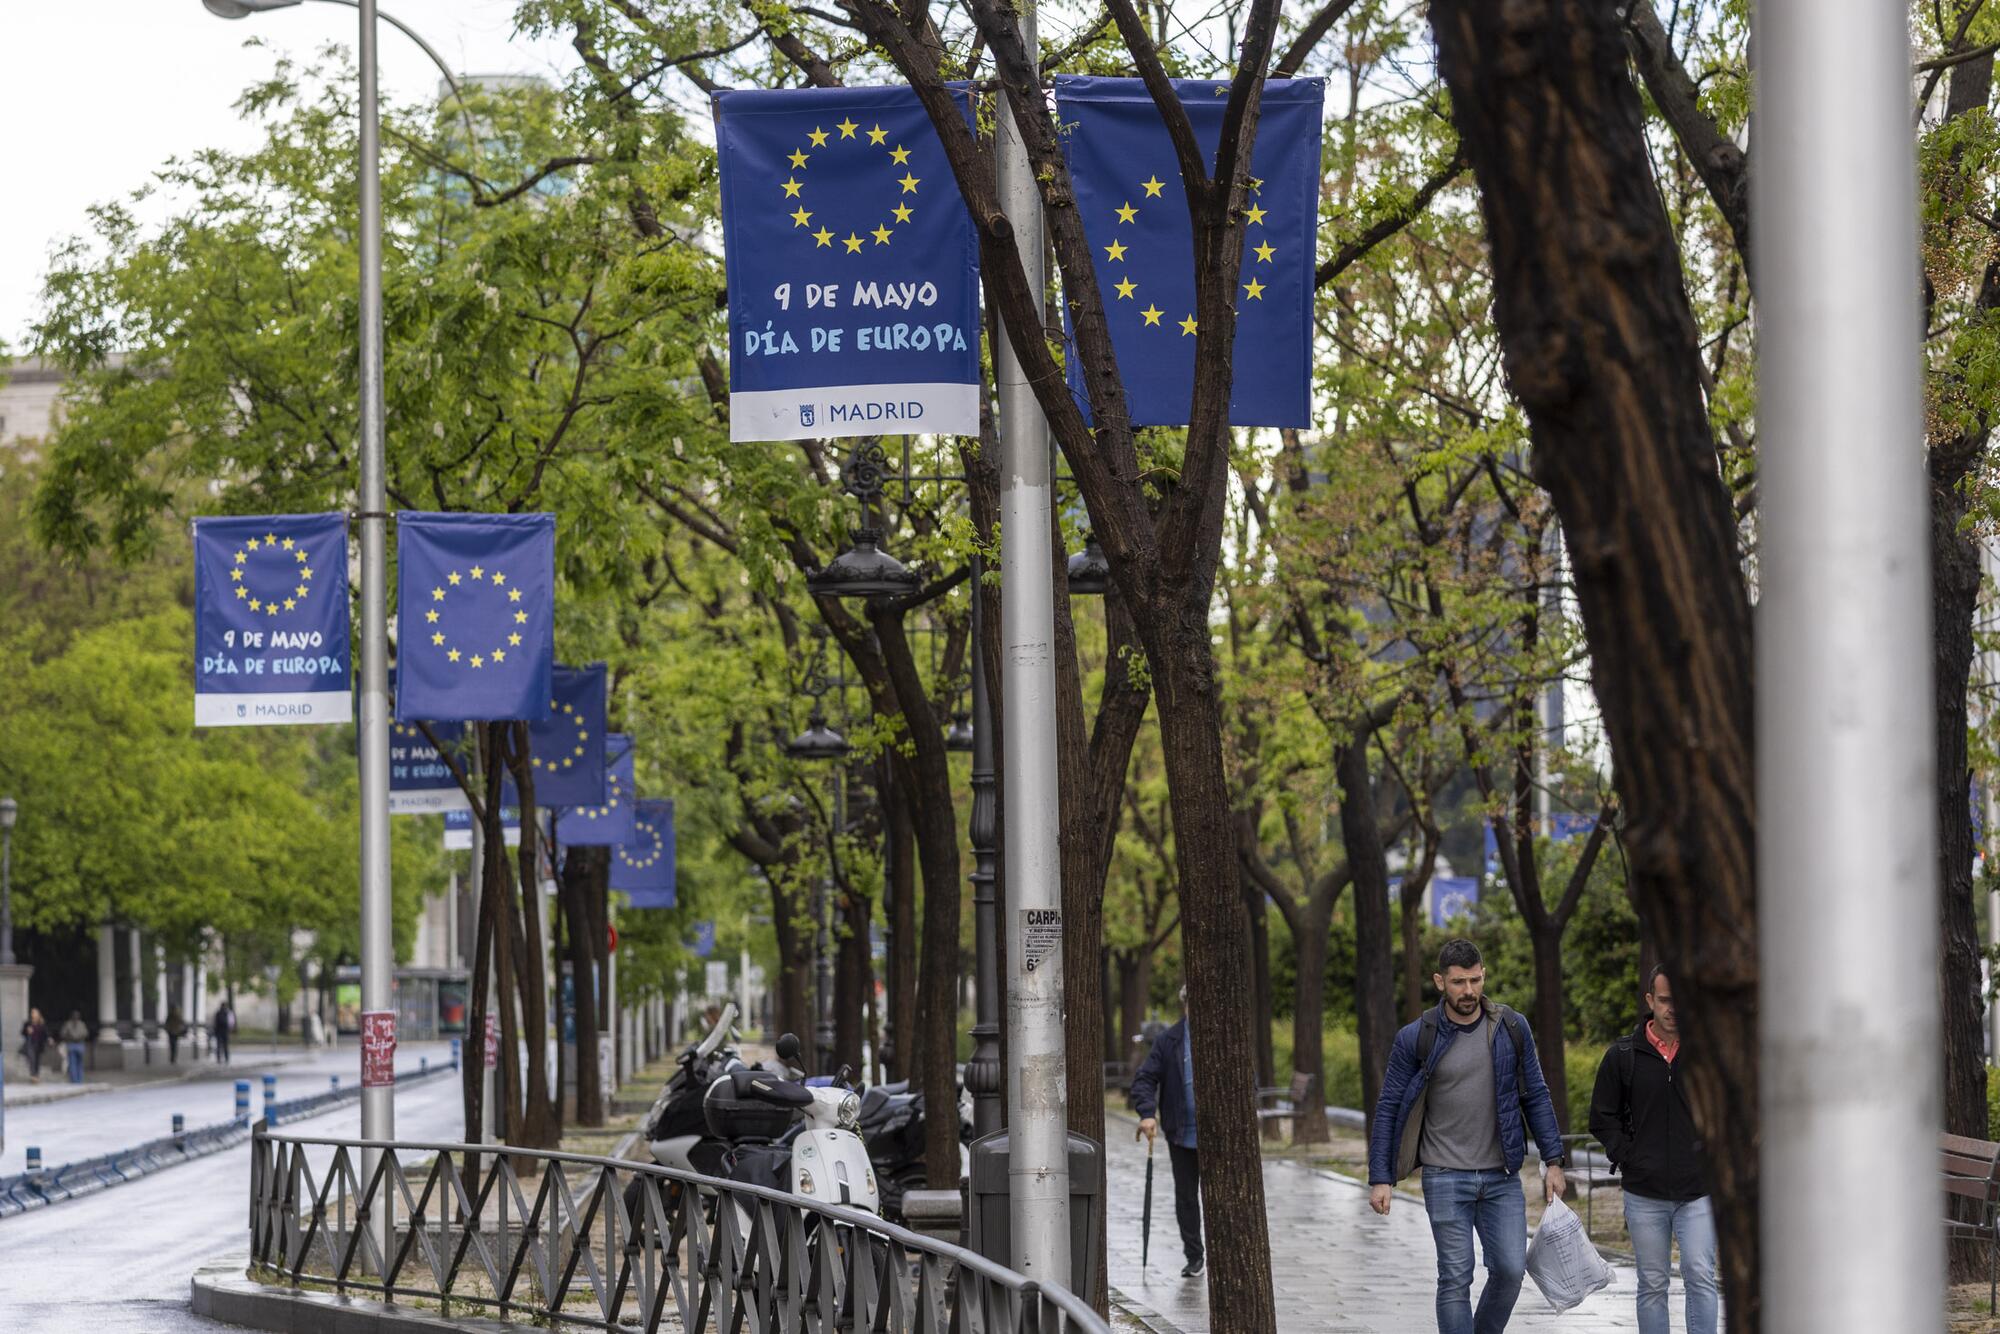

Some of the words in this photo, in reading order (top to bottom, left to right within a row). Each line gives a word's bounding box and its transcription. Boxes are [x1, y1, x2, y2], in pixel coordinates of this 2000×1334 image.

[774, 283, 791, 311] 9
[805, 283, 840, 310] DE
[852, 281, 938, 311] MAYO
[745, 320, 800, 356] DÍA
[811, 327, 844, 353] DE
[856, 323, 968, 353] EUROPA
[830, 401, 924, 423] MADRID
[223, 629, 236, 648] 9
[243, 631, 264, 648] DE
[270, 630, 323, 650] MAYO
[203, 651, 239, 675] DÍA
[245, 657, 266, 675] DE
[272, 656, 342, 675] EUROPA
[255, 703, 313, 717] MADRID
[391, 747, 406, 760] DE
[393, 765, 408, 779] DE
